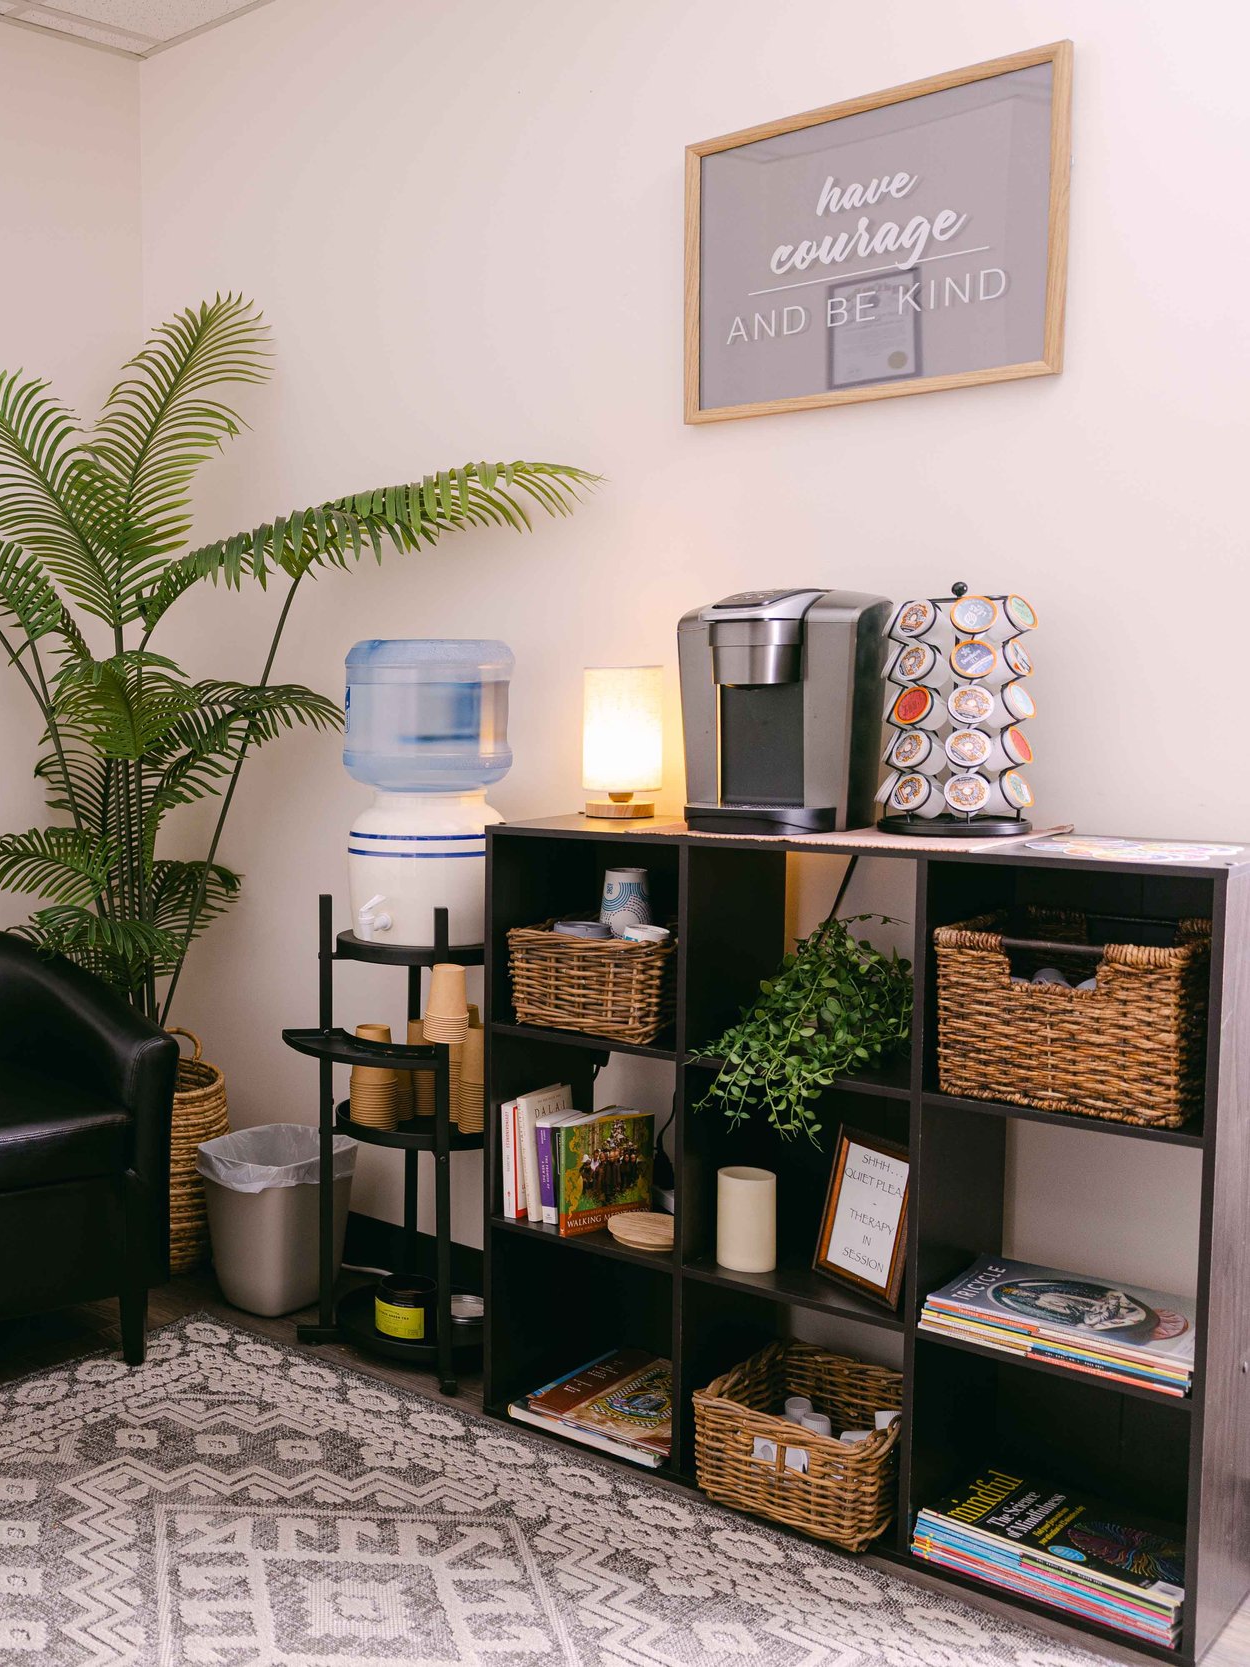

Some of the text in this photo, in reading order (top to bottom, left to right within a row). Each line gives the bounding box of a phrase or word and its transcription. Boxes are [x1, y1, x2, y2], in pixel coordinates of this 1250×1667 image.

[816, 172, 918, 217] have
[770, 209, 967, 275] courage
[726, 305, 806, 345] AND
[826, 290, 877, 328] BE
[898, 268, 1007, 316] KIND
[844, 1167, 904, 1198] QUIET PLEA
[567, 1214, 602, 1229] WALKING
[850, 1207, 895, 1236] THERAPY
[862, 1234, 872, 1247] IN
[842, 1246, 884, 1273] SESSION
[951, 1265, 1007, 1301] TRICYCLE
[947, 1469, 1024, 1523] mindful
[986, 1513, 1015, 1527] The
[1002, 1491, 1041, 1516] Science
[1009, 1493, 1067, 1534] Mindfulness
